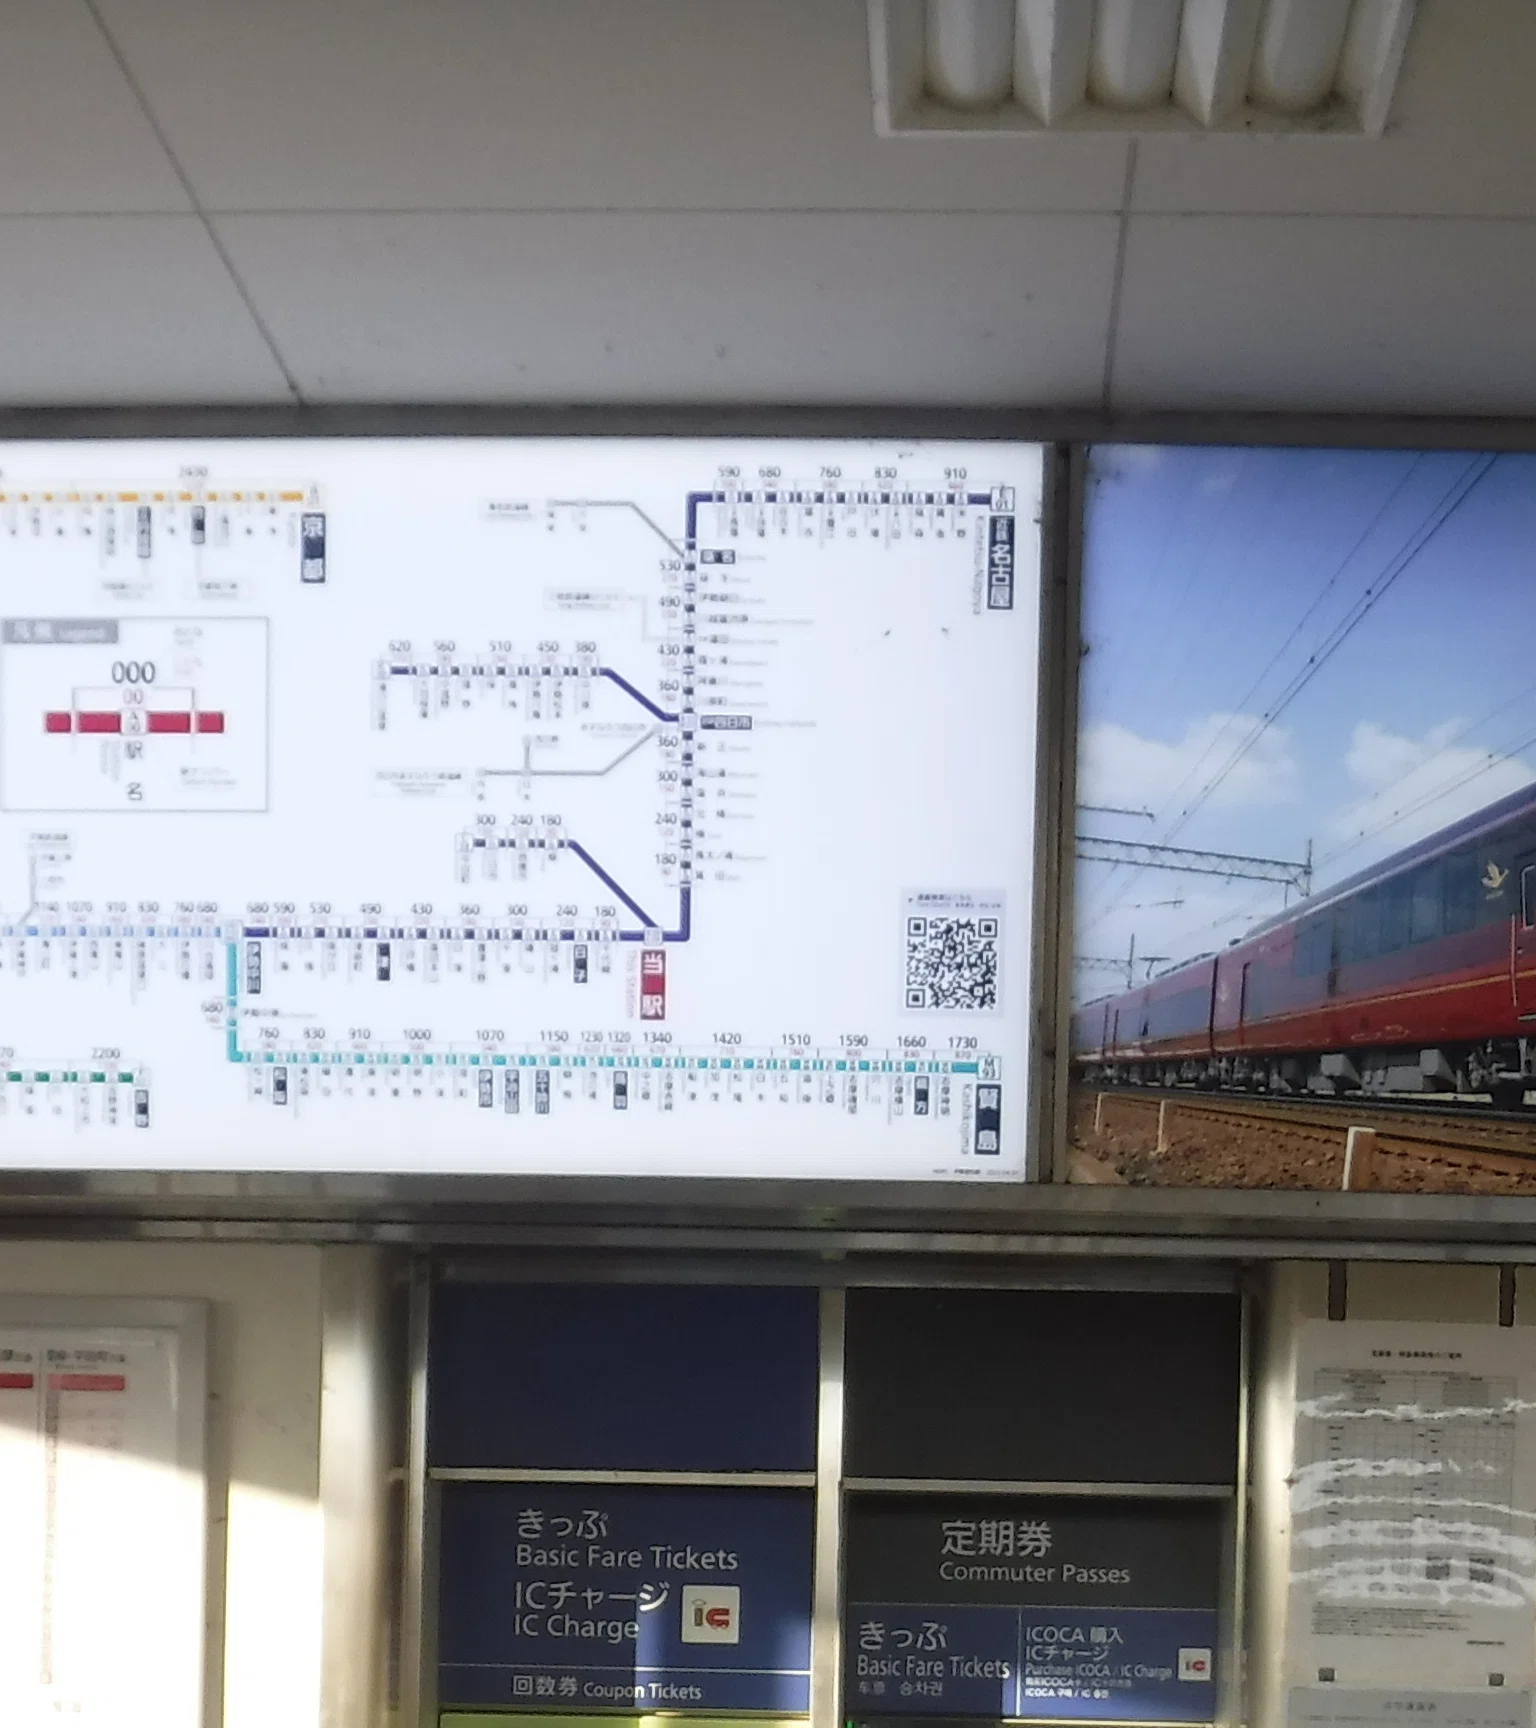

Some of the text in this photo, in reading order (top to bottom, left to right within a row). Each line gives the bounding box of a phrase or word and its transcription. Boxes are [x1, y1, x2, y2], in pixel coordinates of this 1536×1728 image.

[718, 467, 740, 478] 590
[759, 467, 781, 478] 680
[820, 467, 841, 478] 760
[875, 467, 897, 478] 830
[945, 468, 966, 479] 910
[658, 645, 680, 655] 430
[112, 661, 155, 684] 000
[643, 952, 663, 1018] 当駅
[349, 1028, 370, 1039] 910
[476, 1030, 505, 1041] 1070
[540, 1030, 568, 1042] 1150
[643, 1032, 672, 1043] 1340
[713, 1033, 742, 1044] 1420
[781, 1034, 810, 1045] 1510
[839, 1035, 868, 1046] 1590
[897, 1036, 926, 1047] 1660
[948, 1037, 977, 1049] 1730
[517, 1508, 608, 1539] きっぷ
[940, 1520, 1053, 1558] 定期券
[516, 1545, 739, 1571] Basic Fare Tickets
[939, 1562, 1131, 1584] Commuter Passes
[515, 1581, 671, 1612] ICチャージ
[515, 1614, 639, 1644] IC Charge
[1026, 1626, 1085, 1643] ICOCA
[859, 1621, 948, 1650] きっぷ
[1025, 1645, 1109, 1661] ICチャージ
[857, 1655, 1010, 1679] Basic Fare Tickets
[1076, 1664, 1111, 1676] ICOCA
[1121, 1665, 1132, 1677] IC
[512, 1675, 579, 1697] 回数券
[584, 1682, 703, 1701] Coupon Tickets
[1025, 1688, 1055, 1698] ICOCA
